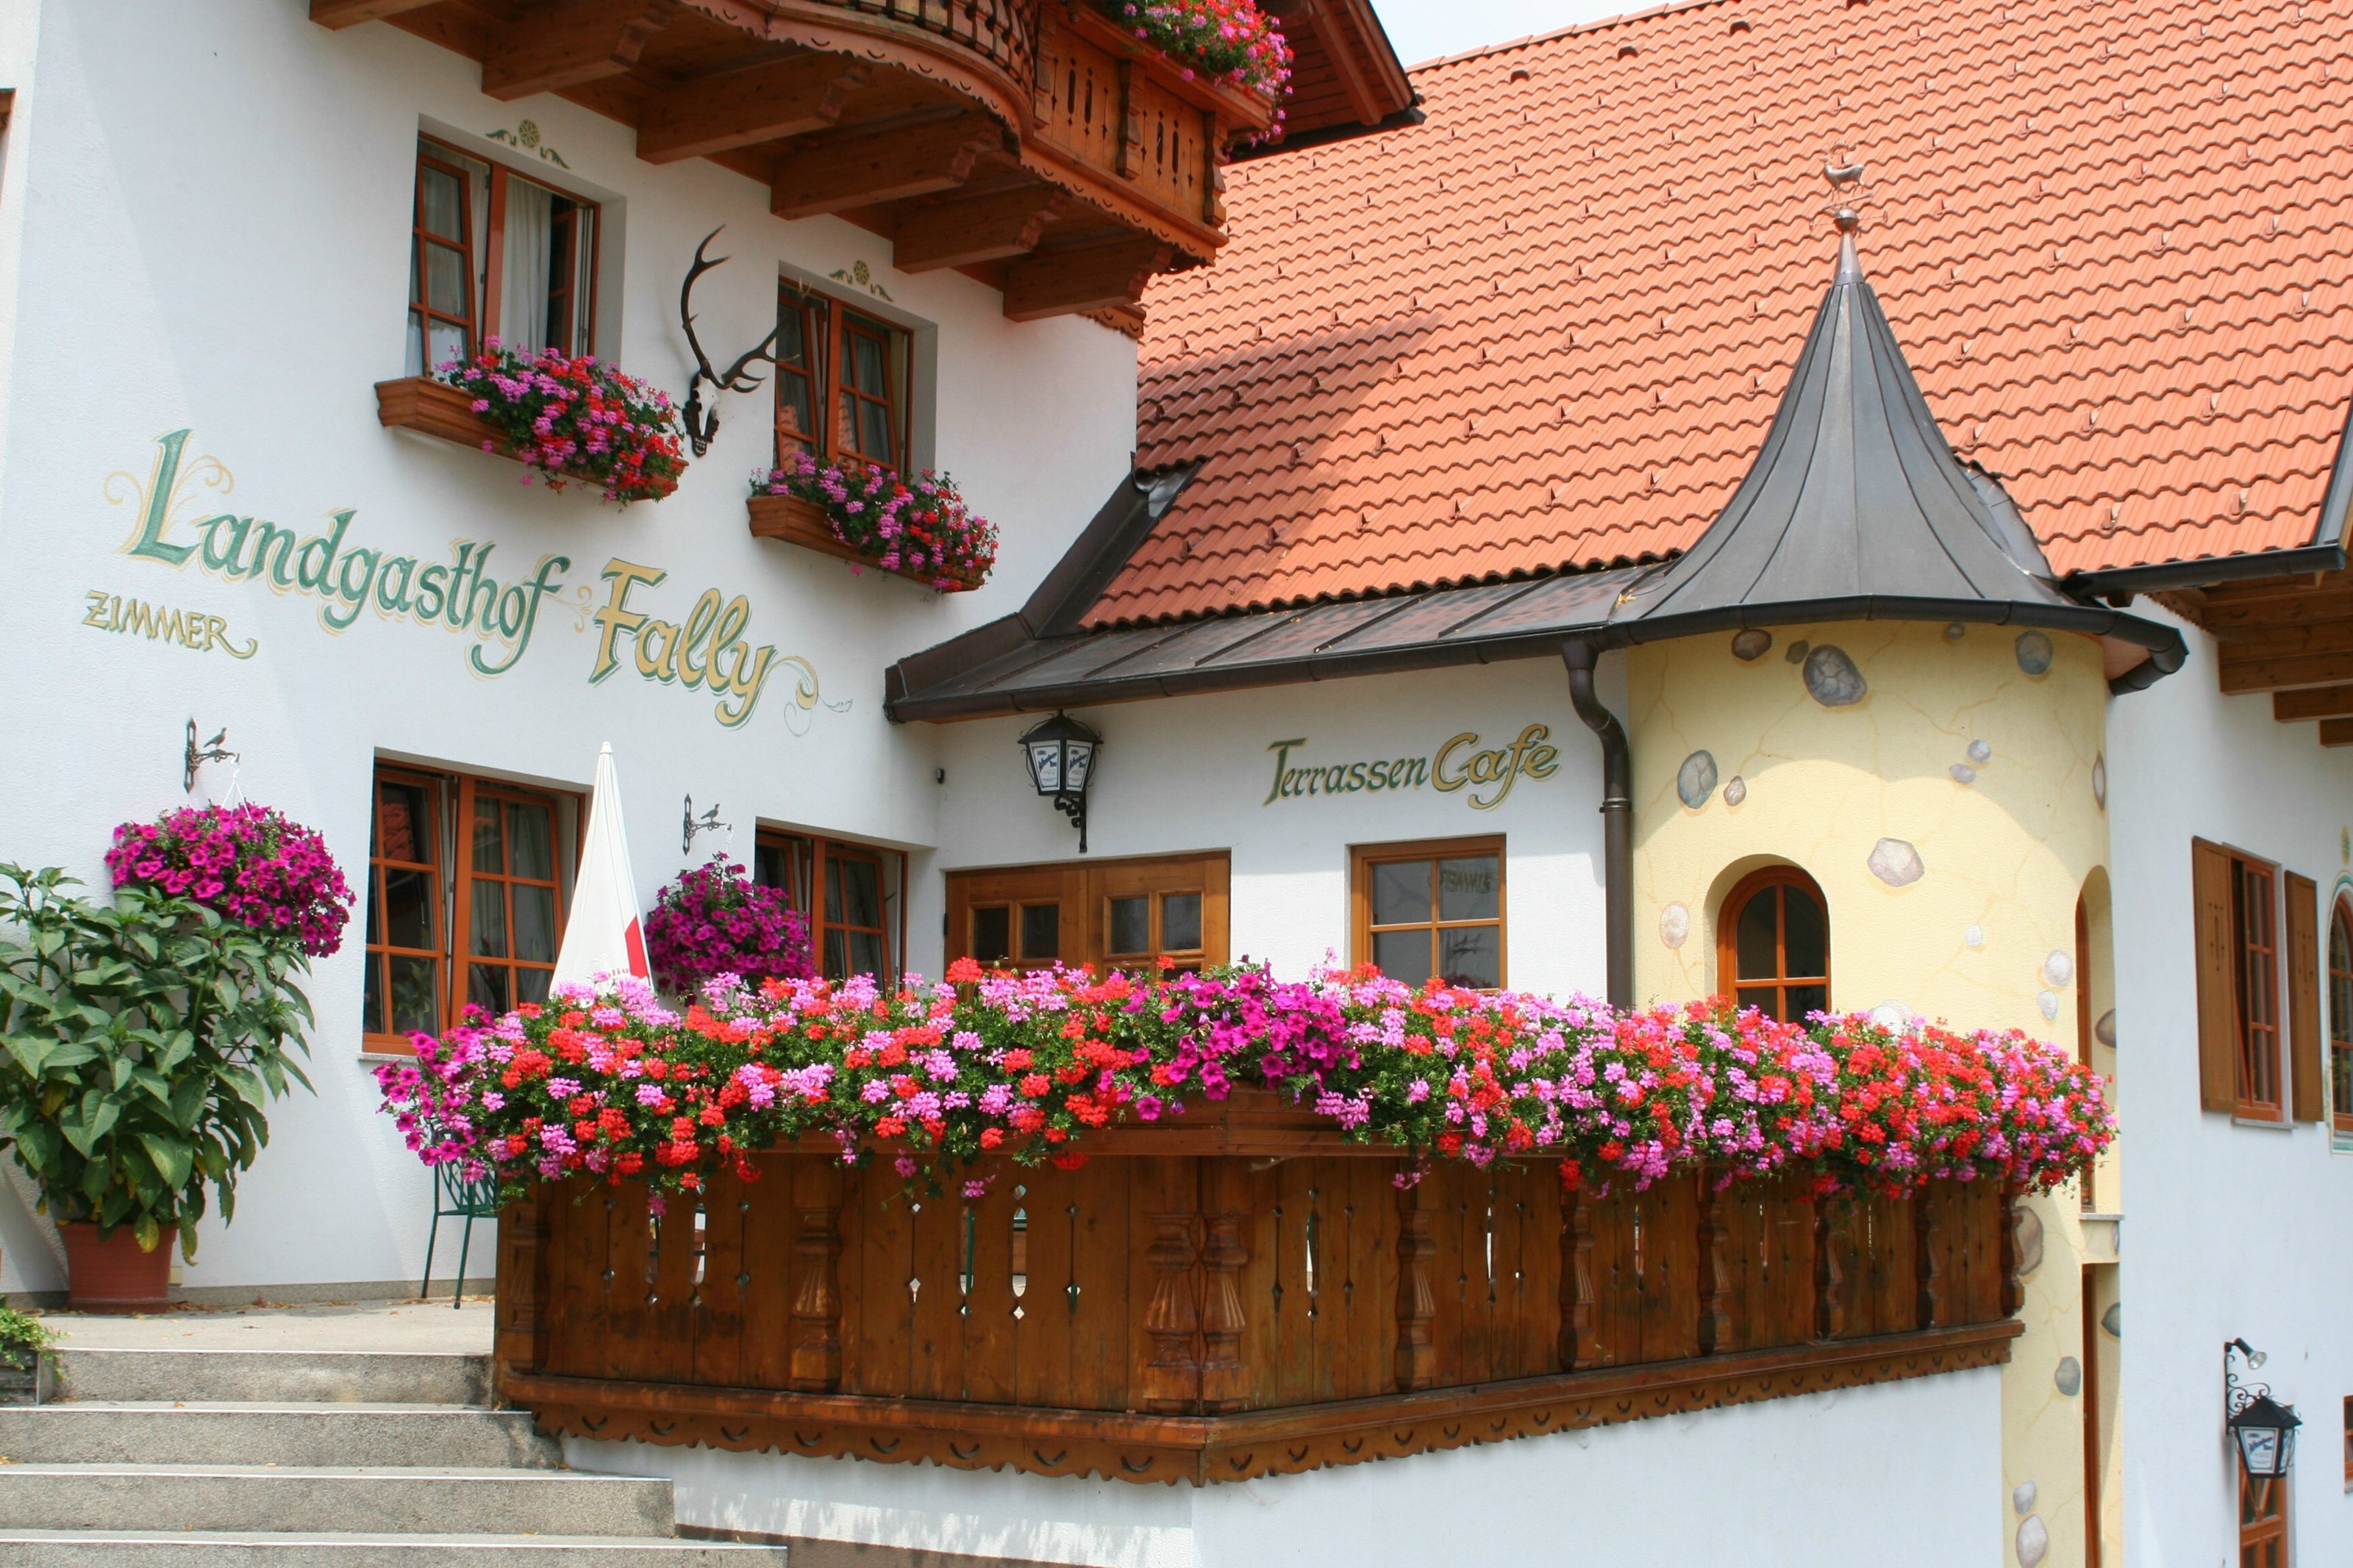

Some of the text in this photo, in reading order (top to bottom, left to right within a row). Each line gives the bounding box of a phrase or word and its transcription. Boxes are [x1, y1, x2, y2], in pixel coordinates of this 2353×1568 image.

[124, 428, 818, 728] Landgasthof Fally
[82, 589, 258, 659] ZIMMER
[1263, 737, 1429, 806] Terrassen
